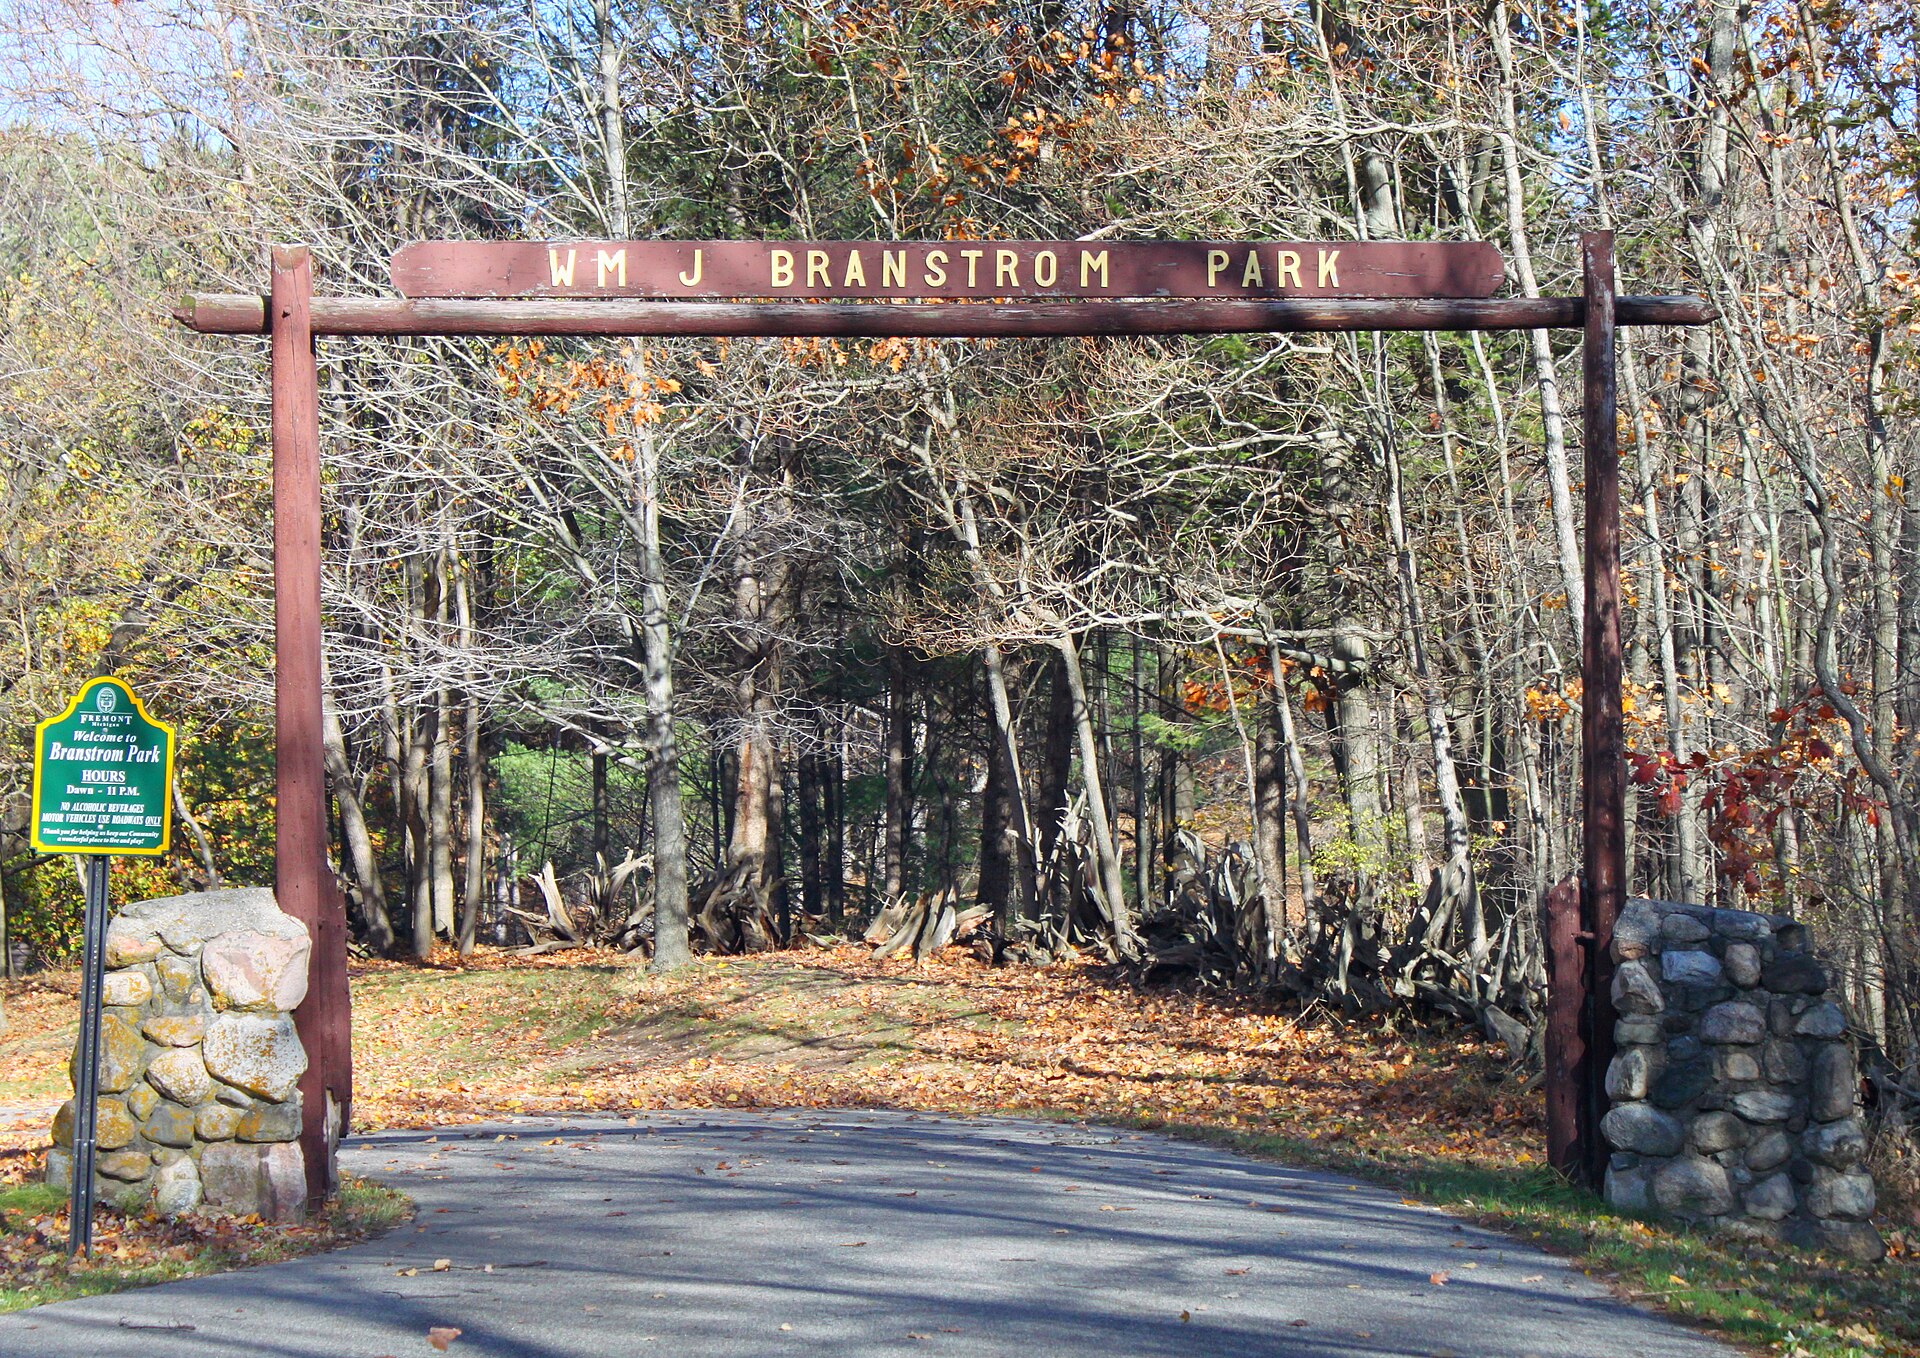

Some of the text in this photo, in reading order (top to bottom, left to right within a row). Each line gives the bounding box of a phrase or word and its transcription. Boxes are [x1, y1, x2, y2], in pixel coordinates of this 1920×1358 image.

[548, 249, 1341, 288] WM J BRANSTROM PARK
[80, 714, 132, 725] FREMONT
[74, 731, 137, 743] Welcome to
[49, 742, 160, 763] Branstrom Park
[81, 770, 126, 783] HOURS
[66, 784, 94, 795] Dawn
[107, 786, 116, 796] 11
[119, 786, 140, 796] P.M.
[60, 801, 144, 813] NO ALCOHOLIC BEVERAGES
[41, 813, 162, 826] MOTOR VEHICLES USE ROADWAYS ONLY
[61, 836, 88, 844] wonderful
[79, 829, 99, 837] helping
[129, 830, 159, 839] Community
